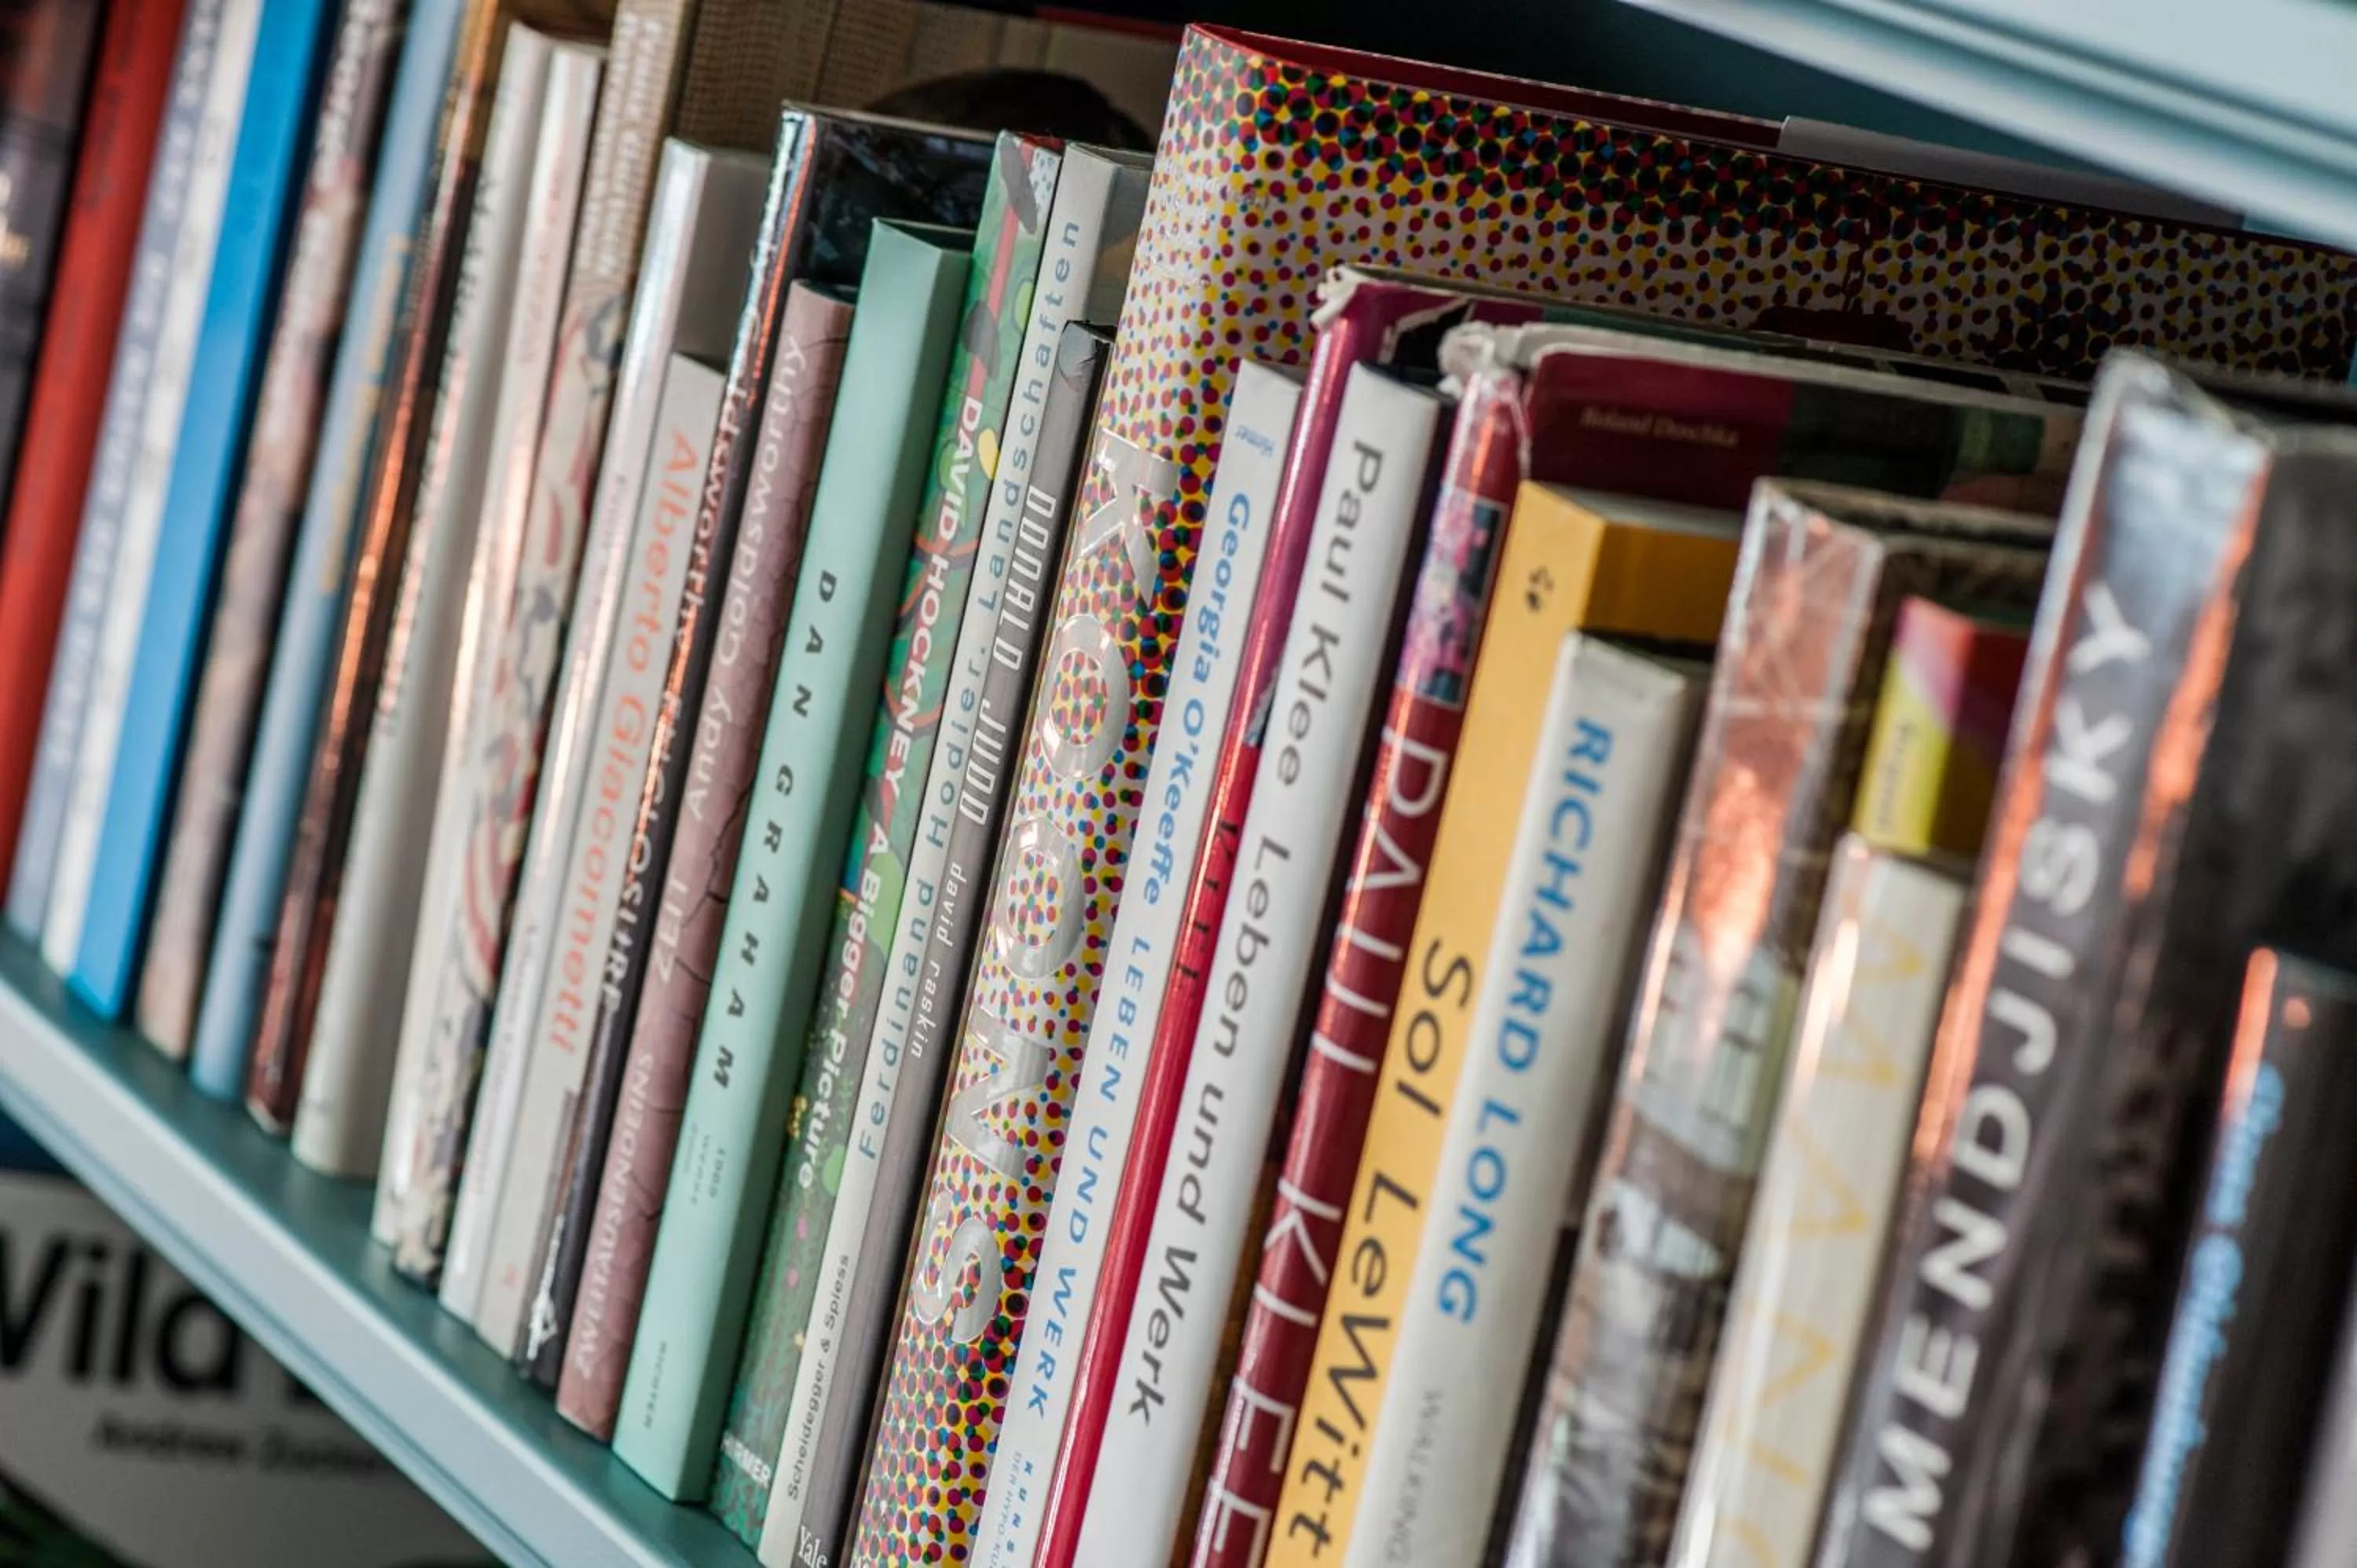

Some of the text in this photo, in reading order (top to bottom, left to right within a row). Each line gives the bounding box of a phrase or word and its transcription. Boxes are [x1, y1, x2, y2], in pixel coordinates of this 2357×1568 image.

[628, 428, 698, 672] Alberto
[687, 687, 735, 821] Andy
[719, 336, 807, 667] Goldsworthy
[858, 878, 934, 1160] Ferdinand
[977, 219, 1080, 611] Landschaften
[959, 484, 1058, 826] DONALD JUDD
[1193, 493, 1250, 685] Georgia
[549, 694, 647, 1055] Giacometti
[652, 877, 692, 985] ZEIT
[713, 570, 838, 1089] DAN GRAHAM
[797, 395, 983, 1189] DAVID HOCKNEY A Bigger Picture
[910, 862, 967, 1059] david raskin
[915, 427, 1178, 1343] KOONS
[1128, 439, 1384, 1425] Paul Klee Leben und Werk
[1069, 1125, 1109, 1244] UND
[1100, 935, 1151, 1102] LEBEN
[1437, 715, 1613, 1325] RICHARD LONG
[1860, 580, 2152, 1551] MENDJISKY
[787, 1254, 849, 1500] Scheidegger & Spiess
[1027, 1266, 1079, 1419] WERK
[1288, 938, 1475, 1559] Sol LeWitt
[798, 1525, 827, 1568] Yale
